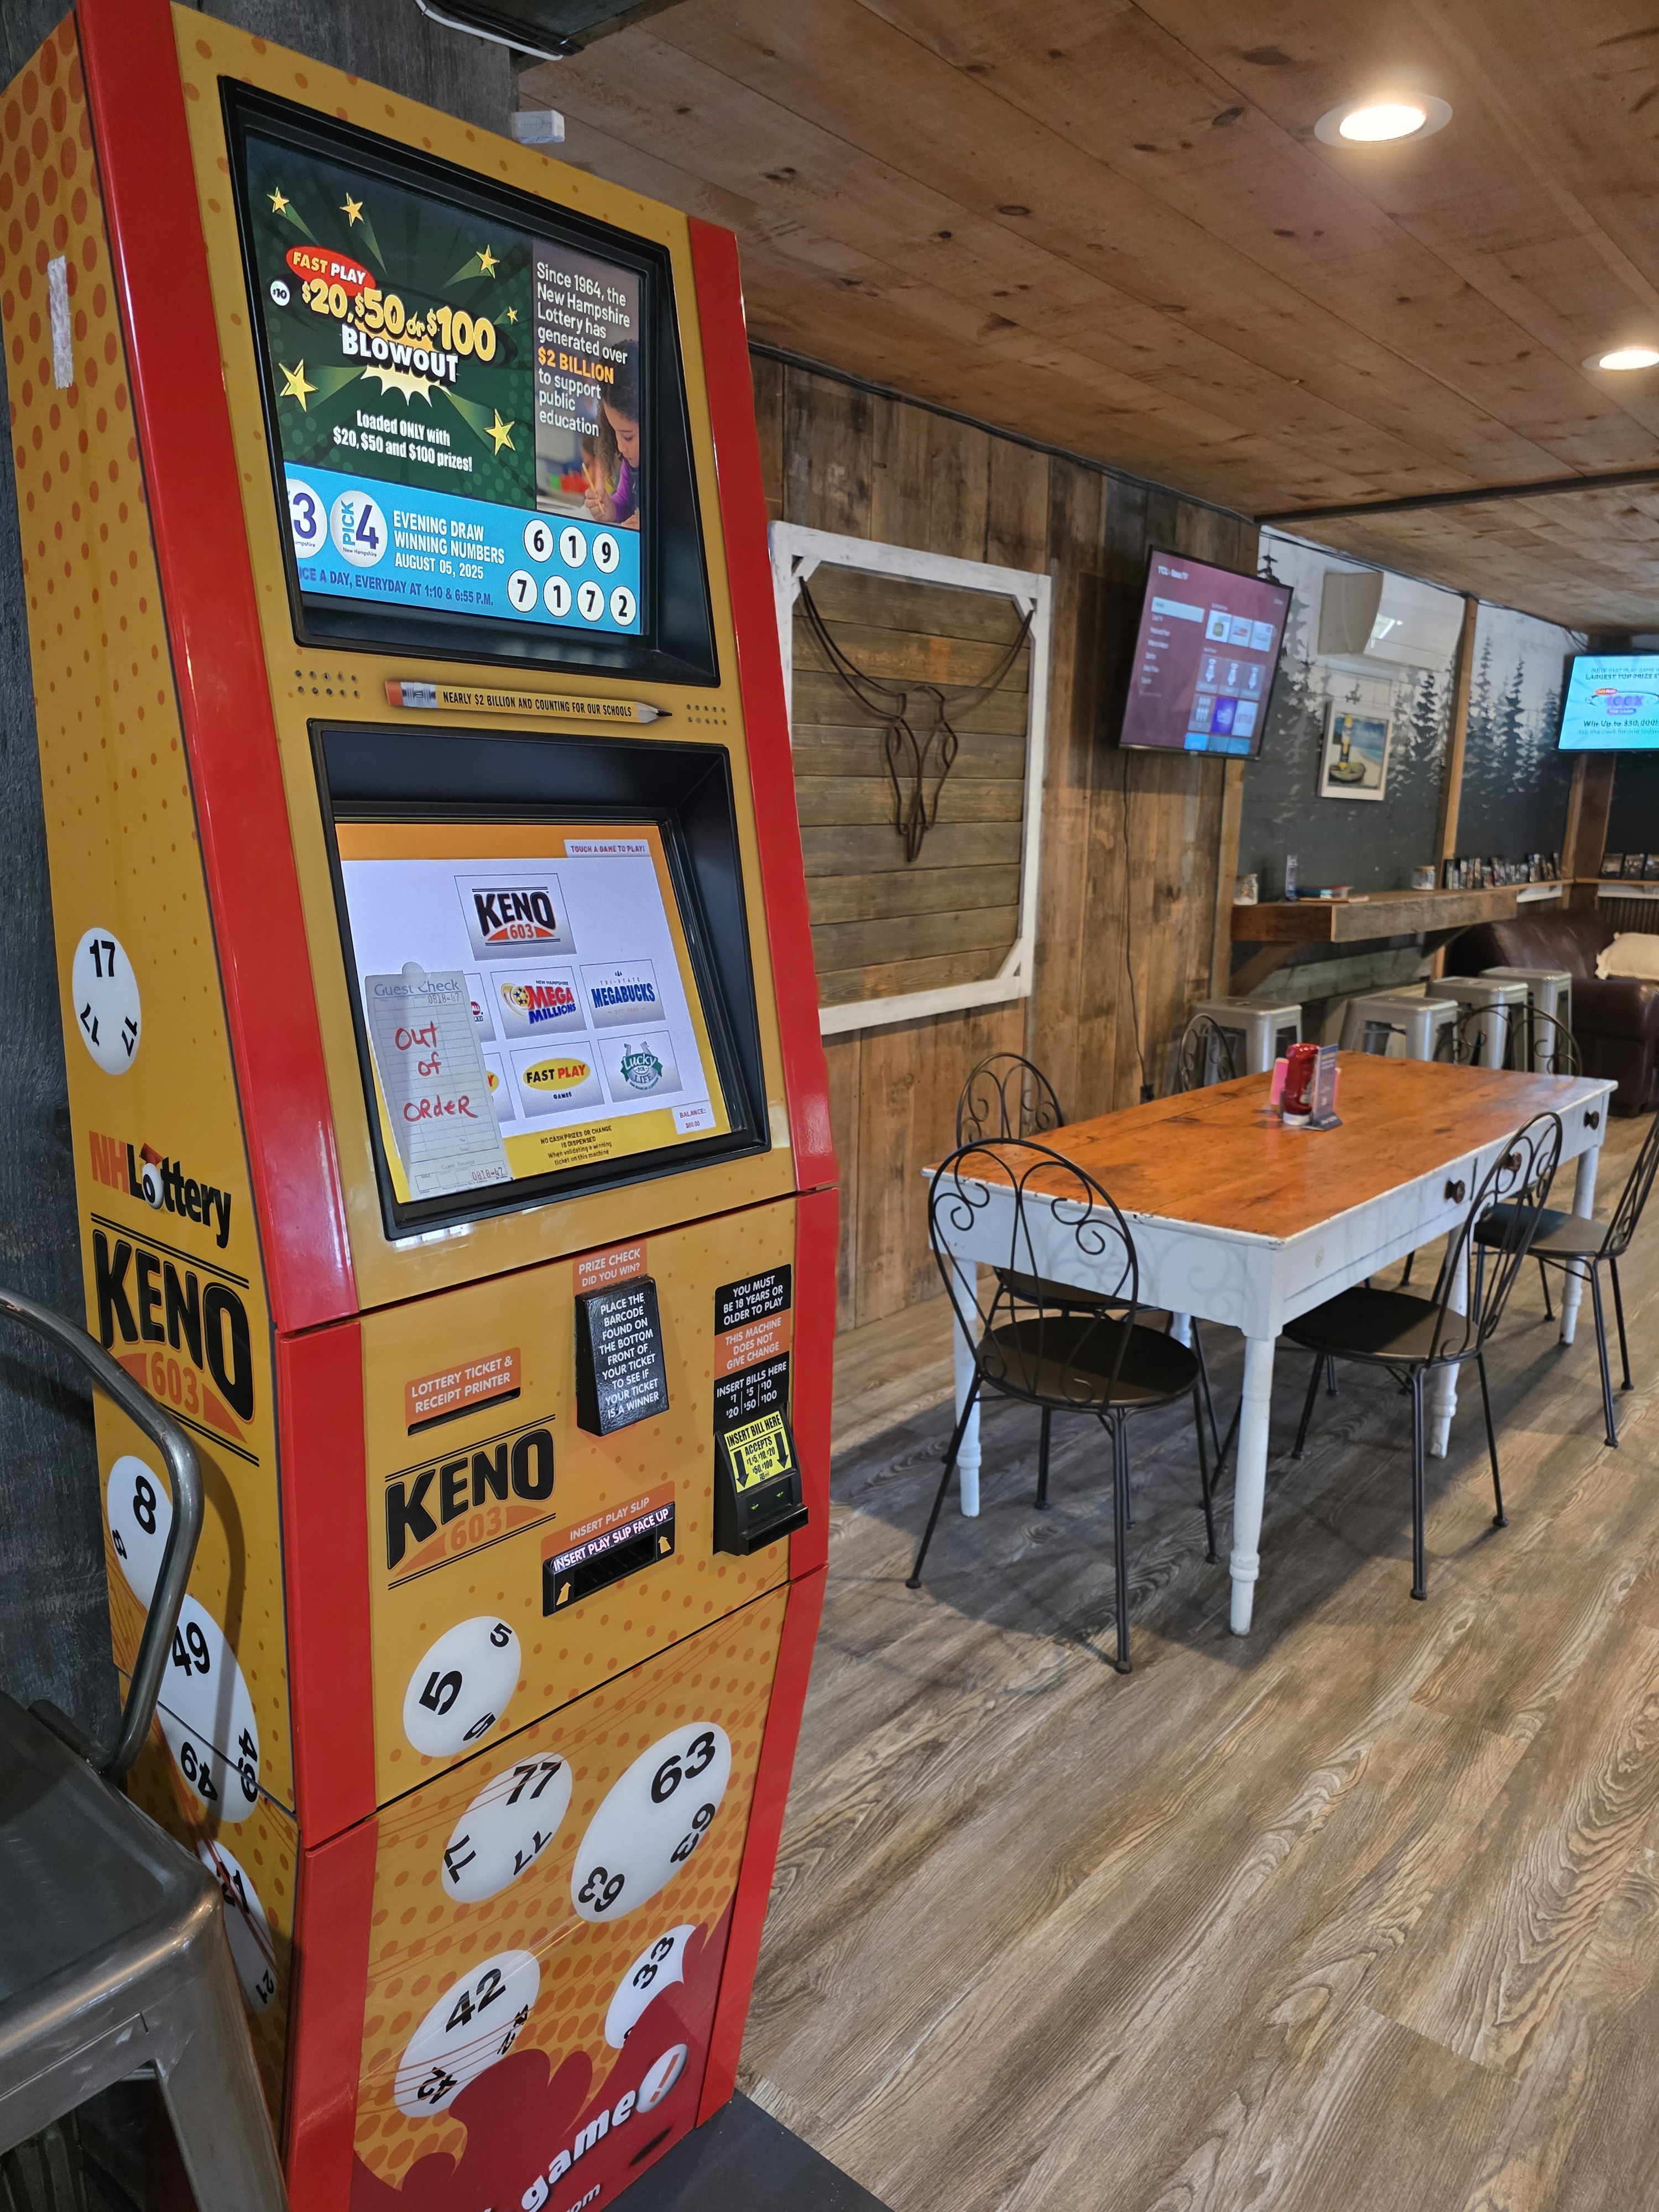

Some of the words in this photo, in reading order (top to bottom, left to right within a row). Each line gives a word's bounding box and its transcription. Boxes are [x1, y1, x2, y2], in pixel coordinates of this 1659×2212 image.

[293, 251, 328, 274] FAST
[331, 263, 367, 285] PLAY
[273, 288, 287, 299] $10
[537, 262, 571, 288] Since
[574, 274, 604, 301] 1964,
[607, 287, 626, 306] the
[537, 283, 565, 306] New
[567, 292, 630, 327] Hampshire
[406, 319, 425, 337] or
[426, 305, 497, 361] $100
[538, 302, 583, 334] Lottery
[586, 317, 606, 338] has
[342, 324, 458, 383] BLOWOUT
[538, 326, 599, 356] generated
[602, 346, 628, 364] over
[538, 346, 556, 368] $2
[560, 353, 614, 384] BILLION
[539, 368, 551, 385] to
[555, 375, 601, 399] support
[540, 389, 576, 411] public
[357, 409, 398, 434] Loaded
[399, 420, 425, 440] ONLY
[427, 427, 450, 446] with
[540, 411, 599, 437] education
[333, 425, 359, 449] $20,
[361, 432, 383, 453] $50
[385, 441, 407, 458] and
[409, 443, 435, 464] $100
[437, 452, 472, 472] prizes!
[293, 493, 316, 539] 3
[341, 500, 356, 546] PICK
[356, 504, 379, 550] 4
[393, 510, 447, 535] EVENING
[451, 520, 484, 542] DRAW
[354, 547, 377, 557] Hampshire
[393, 530, 447, 555] WINNING
[450, 542, 505, 565] NUMBERS
[394, 552, 435, 572] AUGUST
[440, 560, 456, 577] 05,
[459, 564, 484, 580] 2025
[299, 568, 316, 581] ICE
[320, 570, 327, 583] A
[330, 571, 353, 589] DAY,
[355, 575, 408, 593] EVERYDAY
[410, 582, 422, 596] AT
[424, 585, 442, 599] 1:10
[446, 588, 452, 599] &
[455, 589, 473, 603] 6:55
[476, 593, 494, 606] P.M.
[443, 691, 472, 705] NEARLY
[475, 693, 484, 707] $2
[487, 695, 515, 708] BILLION
[518, 698, 532, 709] AND
[535, 698, 570, 712] COUNTING
[572, 702, 585, 713] FOR
[587, 703, 600, 714] OUR
[603, 704, 632, 717] SCHOOLS
[473, 891, 556, 937] KENO
[509, 924, 534, 940] 603
[89, 939, 116, 978] 17
[374, 983, 414, 996] Guest
[524, 985, 575, 1010] MEGA
[591, 983, 655, 1009] MEGABUCKS
[529, 1003, 576, 1024] MILLIONS
[418, 1052, 441, 1077] of
[526, 1068, 555, 1084] FAST
[558, 1064, 586, 1079] PLAY
[623, 1052, 657, 1070] Lucky
[635, 1073, 653, 1083] LIFE
[679, 1108, 706, 1118] BALANCE:
[564, 1131, 583, 1140] PRIZES
[592, 1125, 612, 1134] CHANGE
[568, 1136, 596, 1147] DISPENSED
[564, 1146, 588, 1155] validating
[588, 1150, 609, 1158] machine
[472, 1167, 504, 1181] 0818-47
[88, 1130, 231, 1249] NHLottery
[578, 1258, 606, 1275] PRIZE
[609, 1248, 640, 1266] CHECK
[582, 1275, 597, 1287] DID
[599, 1269, 617, 1282] YOU
[619, 1262, 640, 1276] WIN?
[723, 1303, 733, 1313] BE
[735, 1299, 744, 1310] 18
[745, 1290, 770, 1305] YEARS
[772, 1285, 783, 1296] OR
[733, 1284, 751, 1298] YOU
[753, 1275, 775, 1291] MUST
[600, 1298, 627, 1315] PLACE
[628, 1293, 644, 1306] THE
[604, 1306, 644, 1327] BARCODE
[723, 1309, 750, 1326] OLDER
[752, 1305, 763, 1316] TO
[764, 1296, 783, 1311] PLAY
[92, 1228, 254, 1423] KENO
[602, 1324, 632, 1340] FOUND
[635, 1317, 648, 1329] ON
[599, 1342, 616, 1355] THE
[618, 1329, 653, 1349] BOTTOM
[608, 1348, 635, 1366] FRONT
[637, 1343, 648, 1354] OF
[602, 1364, 627, 1380] YOUR
[628, 1353, 655, 1371] TICKET
[612, 1379, 624, 1390] TO
[627, 1372, 640, 1385] SEE
[642, 1369, 649, 1379] IF
[717, 1379, 745, 1398] INSERT
[746, 1370, 766, 1385] BILLS
[768, 1361, 787, 1377] HERE
[151, 1352, 199, 1415] 603
[605, 1390, 630, 1406] YOUR
[632, 1379, 658, 1396] TICKET
[608, 1409, 615, 1419] IS
[618, 1405, 624, 1414] A
[627, 1391, 659, 1410] WINNER
[727, 1428, 750, 1447] INSERT
[750, 1422, 765, 1437] BILL
[764, 1415, 781, 1429] HERE
[745, 1436, 773, 1455] ACCEPTS
[133, 1475, 156, 1535] 8
[385, 1429, 553, 1569] KENO
[450, 1506, 502, 1551] 603
[552, 1546, 586, 1571] INSERT
[588, 1535, 610, 1555] PLAY
[612, 1525, 632, 1545] SLIP
[634, 1515, 655, 1534] FACE
[656, 1508, 669, 1522] UP
[172, 1621, 210, 1677] 49
[419, 1670, 462, 1715] 5
[650, 1731, 715, 1804] 63
[506, 1762, 562, 1806] 77
[633, 1937, 675, 1990] 33
[445, 1968, 506, 2033] 42
